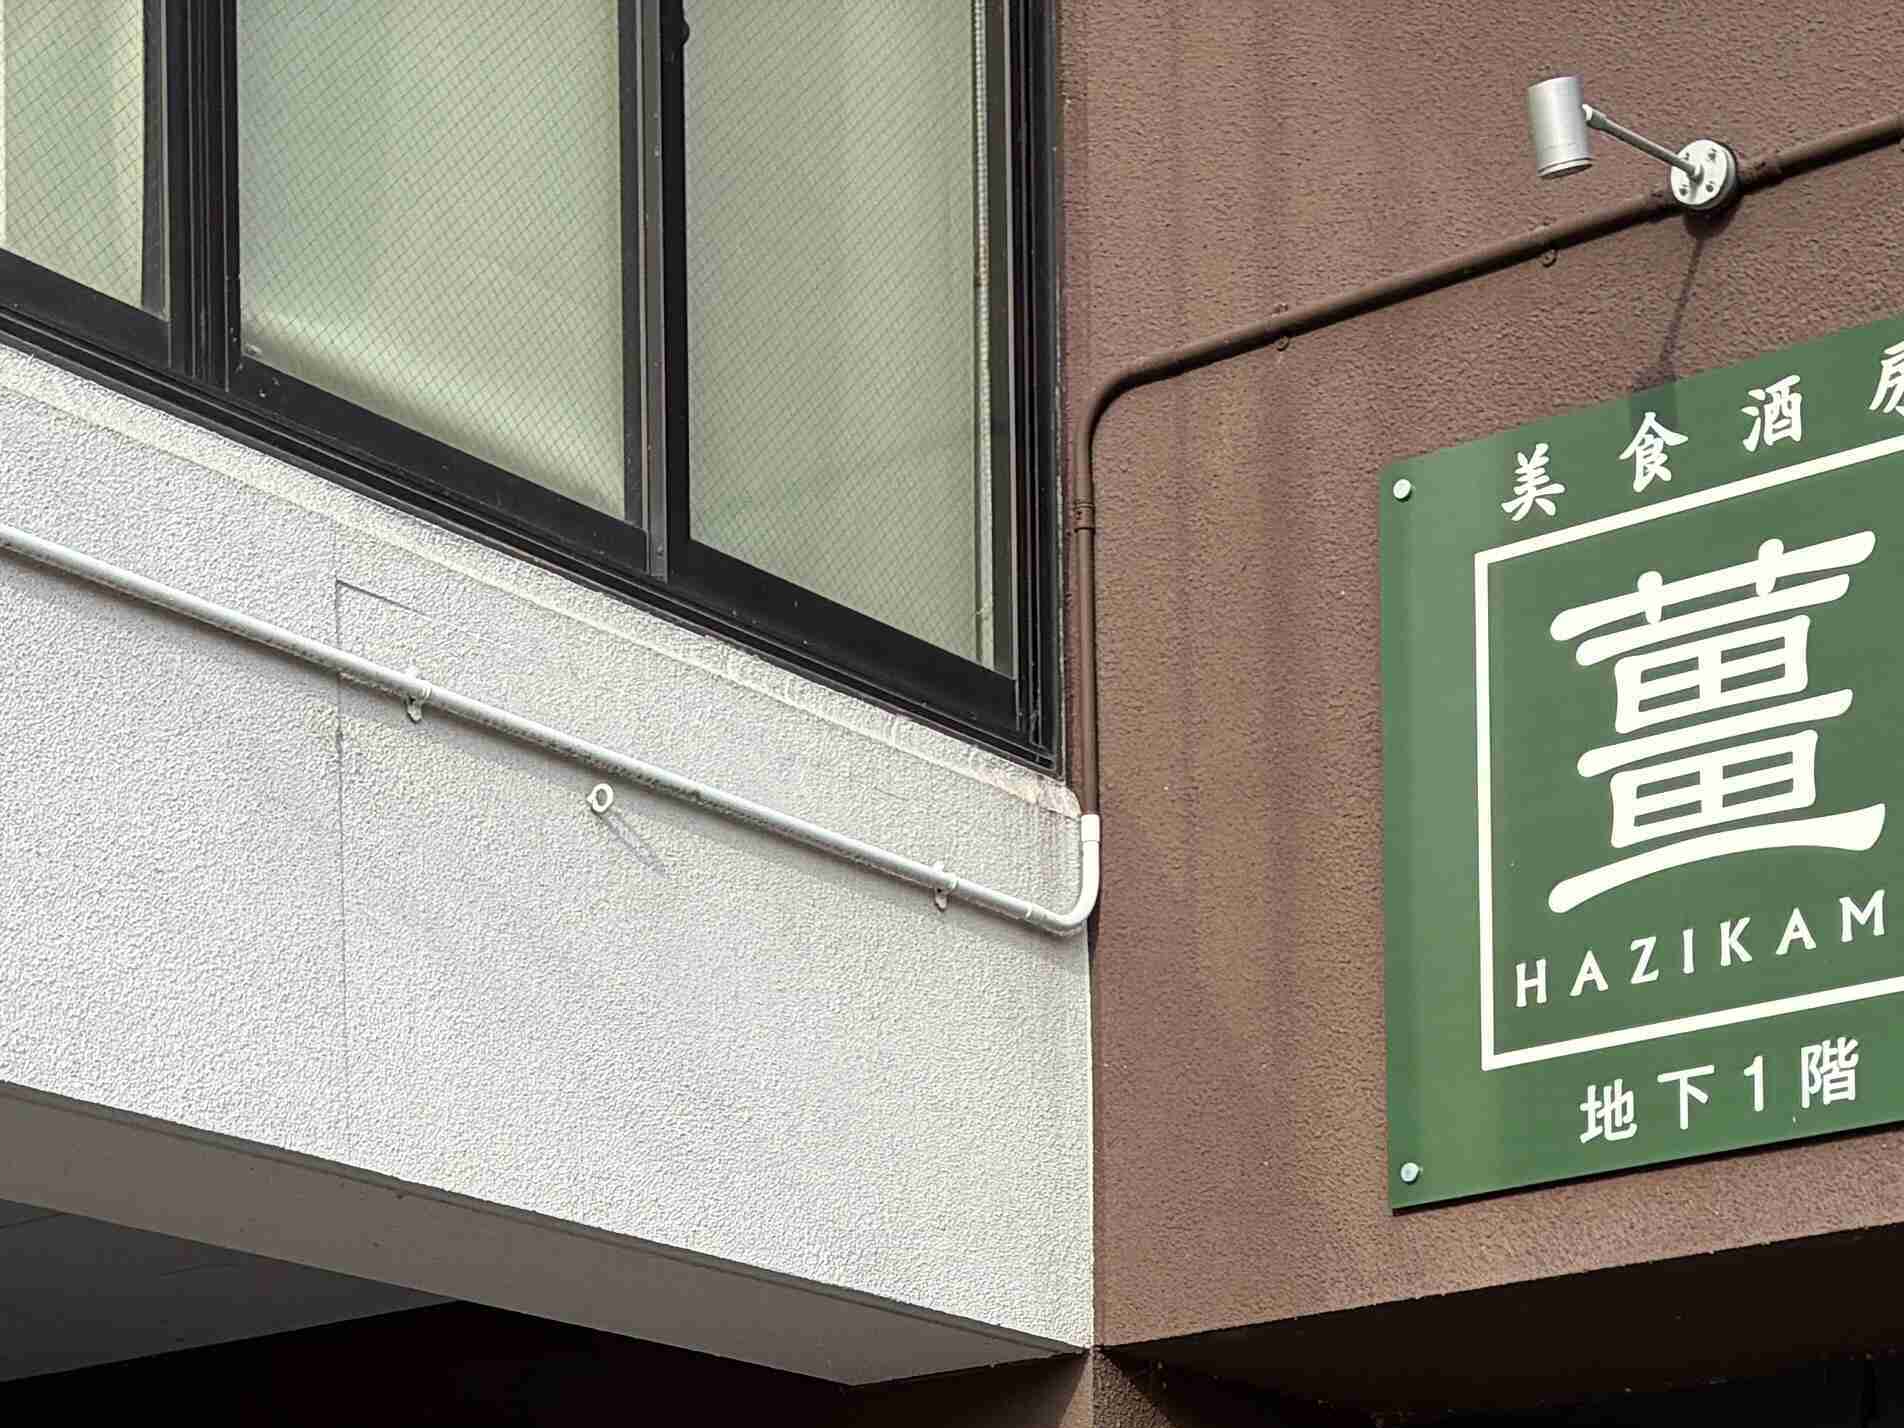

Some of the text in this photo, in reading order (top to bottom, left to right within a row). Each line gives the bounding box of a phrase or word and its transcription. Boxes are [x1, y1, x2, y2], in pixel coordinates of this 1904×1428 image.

[1548, 530, 1887, 915] 薑
[1579, 1036, 1860, 1145] 地下1階
